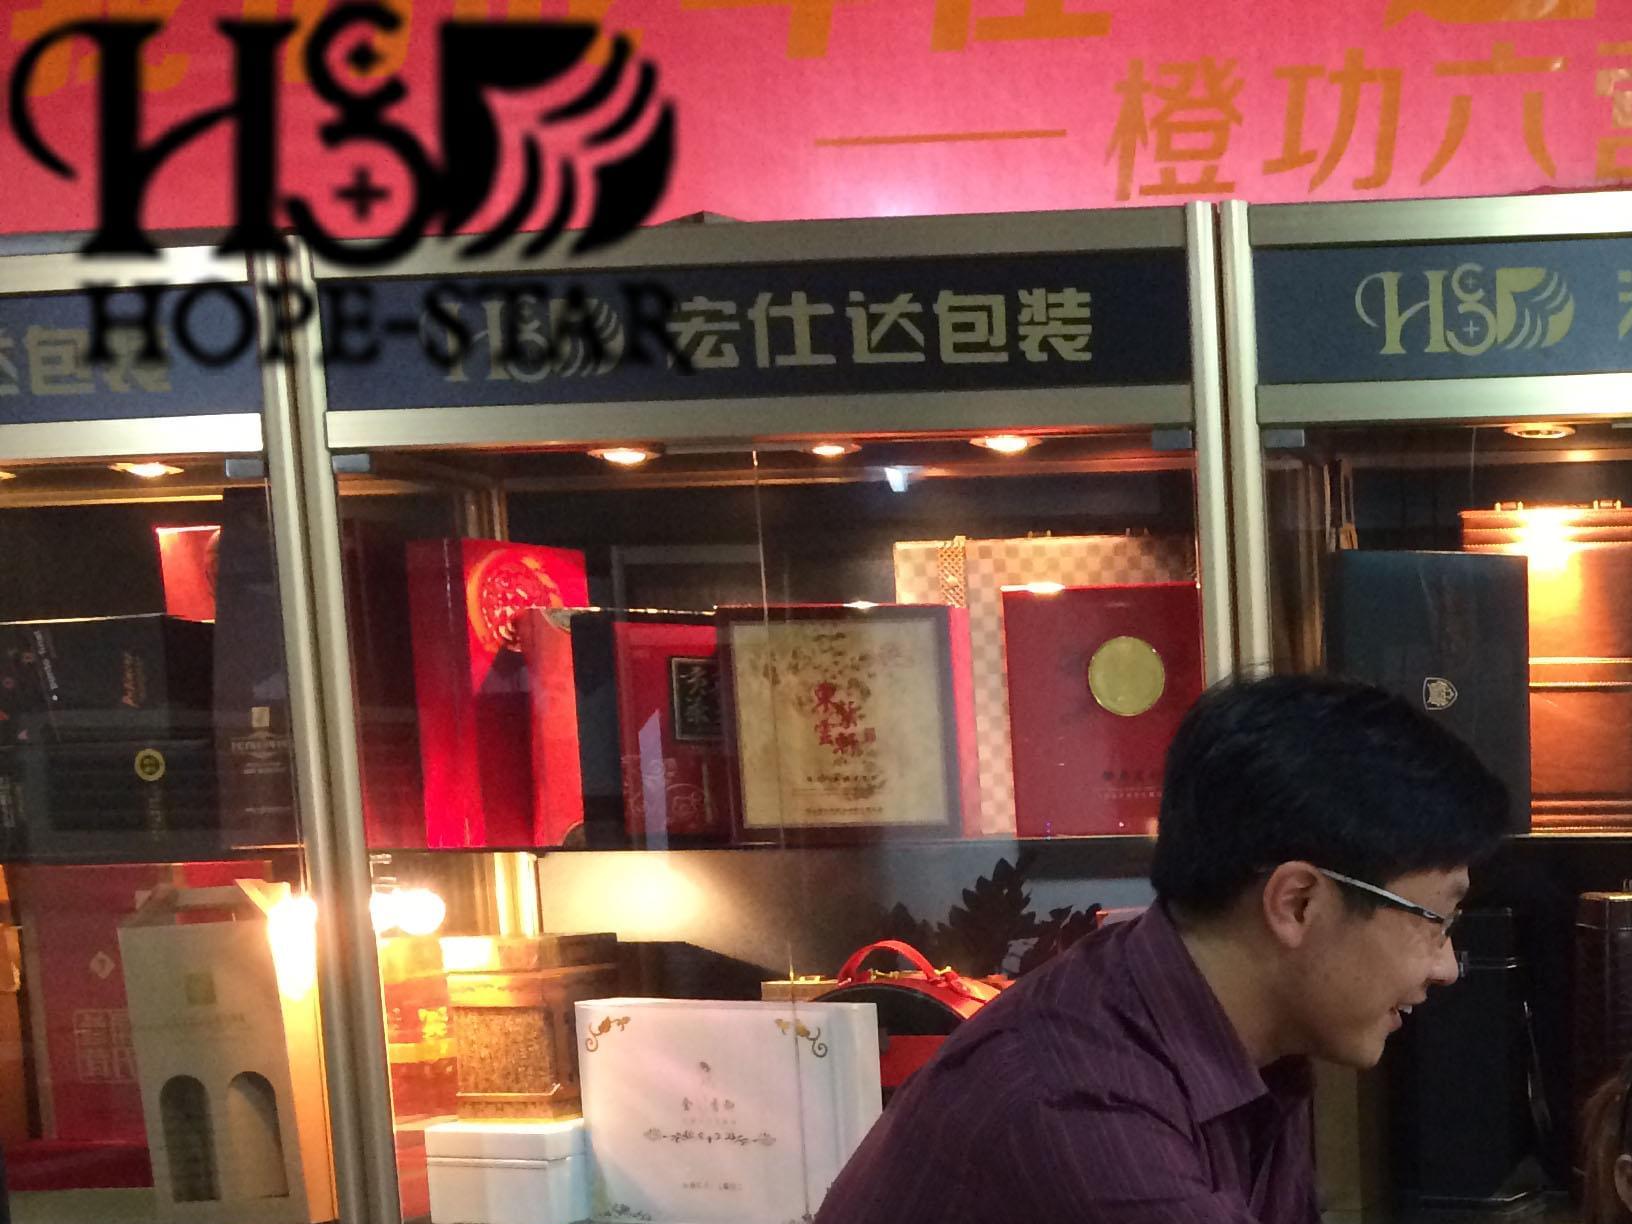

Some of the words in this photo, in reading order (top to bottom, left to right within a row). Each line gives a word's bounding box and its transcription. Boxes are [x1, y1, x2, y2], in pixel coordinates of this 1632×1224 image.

[666, 287, 1094, 370] 宏仕达包装
